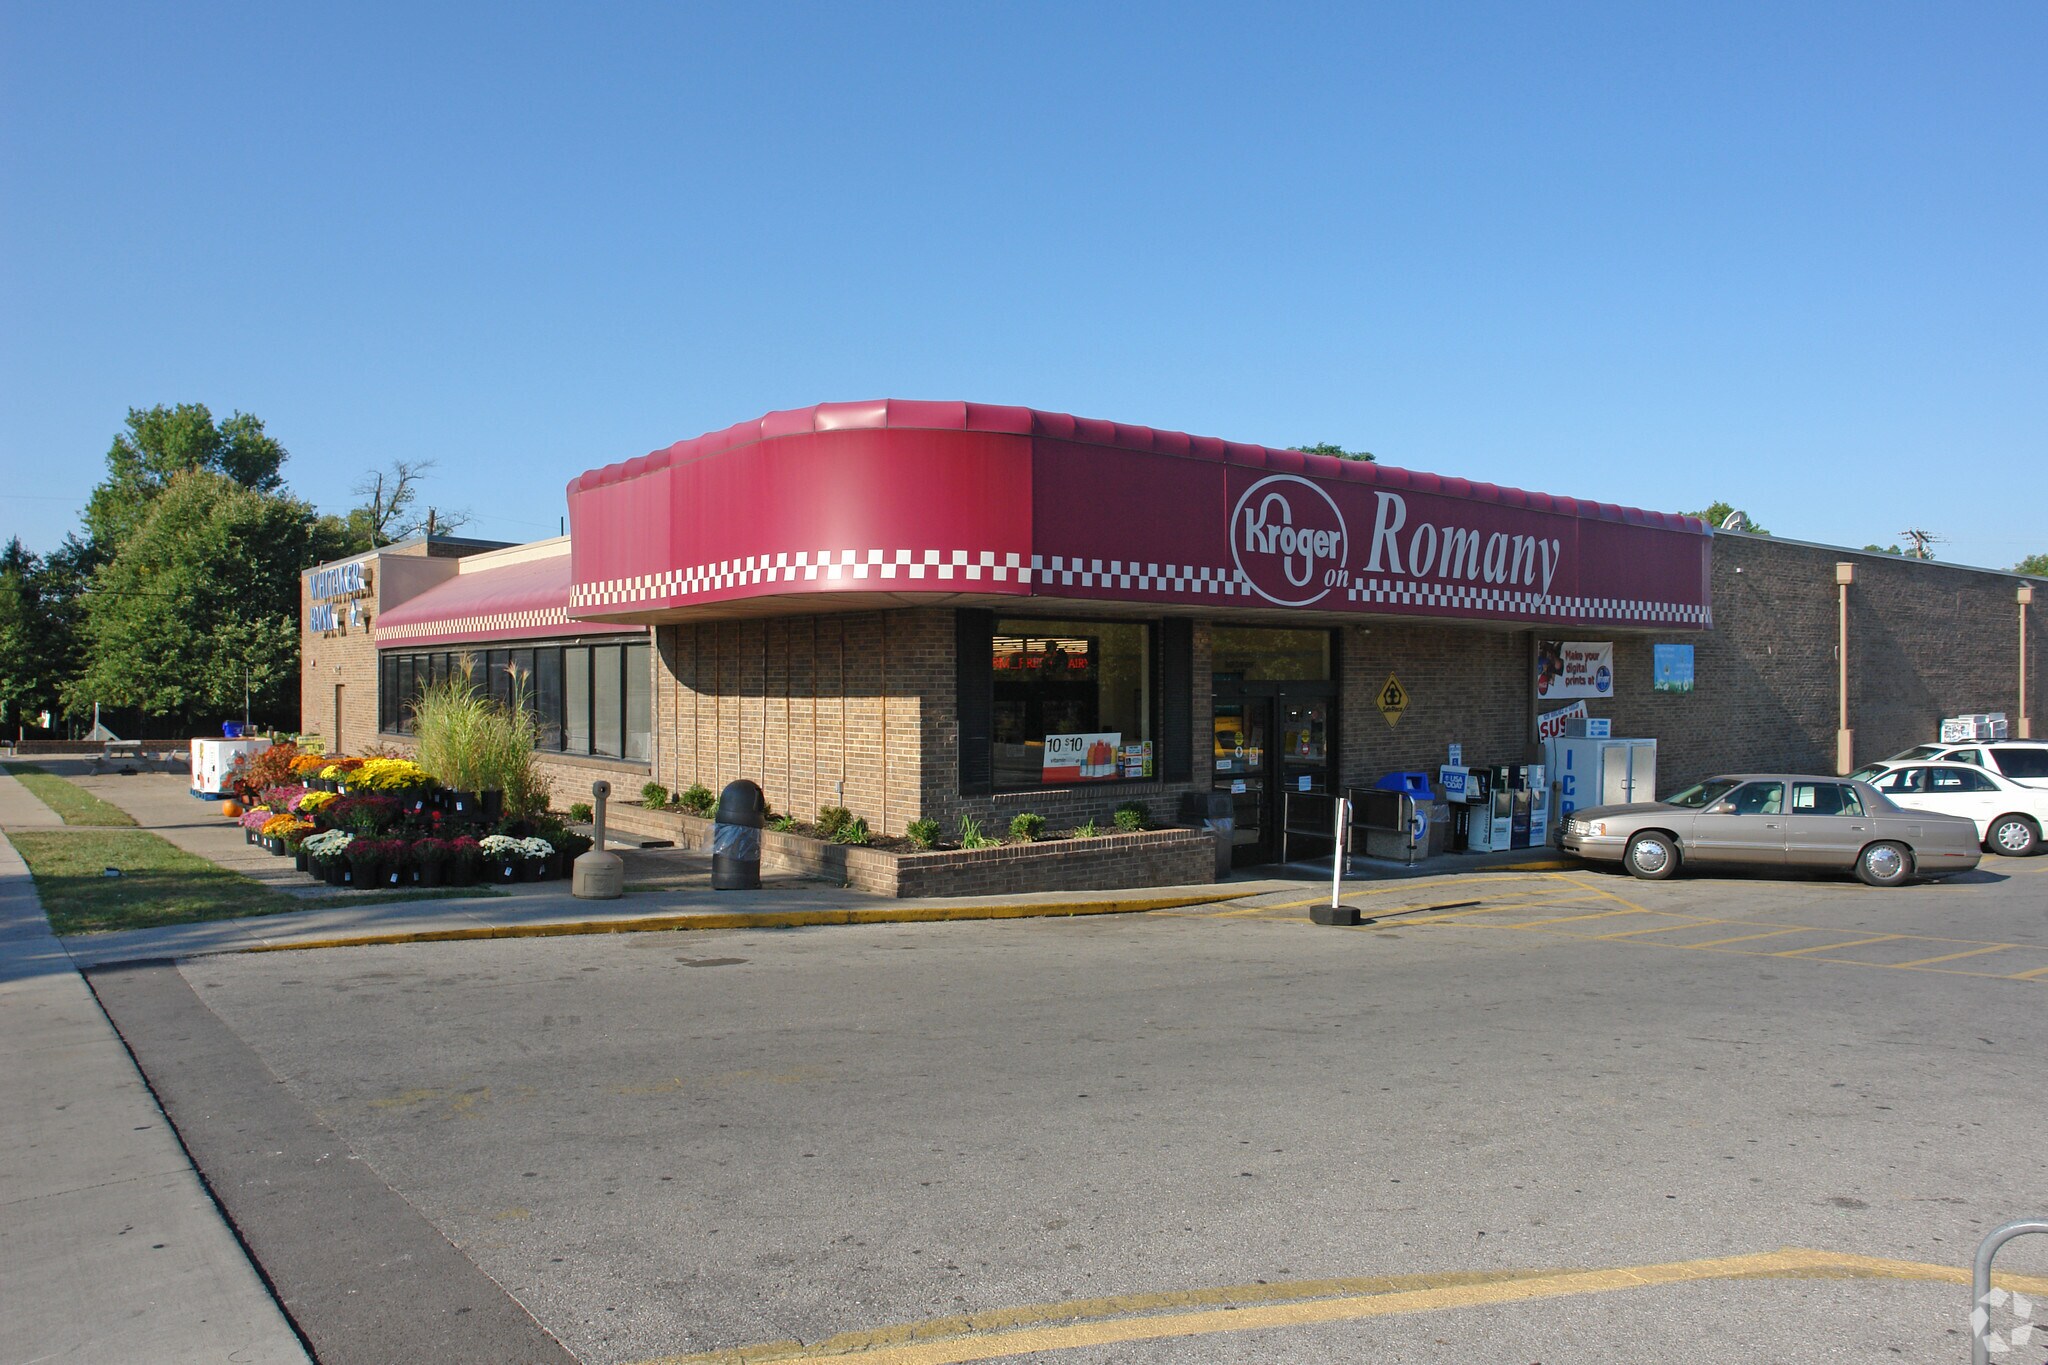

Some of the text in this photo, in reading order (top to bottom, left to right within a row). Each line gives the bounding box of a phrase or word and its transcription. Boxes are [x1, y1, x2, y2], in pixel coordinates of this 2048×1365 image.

[1244, 490, 1560, 608] Kroger on Romany
[309, 562, 362, 600] WHITAKER
[1565, 650, 1600, 663] Make your
[1566, 661, 1588, 675] digital
[1565, 675, 1586, 688] prints
[1588, 675, 1595, 685] at
[1540, 708, 1584, 738] SUS
[1047, 737, 1083, 753] 10 $10
[1444, 781, 1463, 789] TODAY
[1450, 775, 1463, 783] USA
